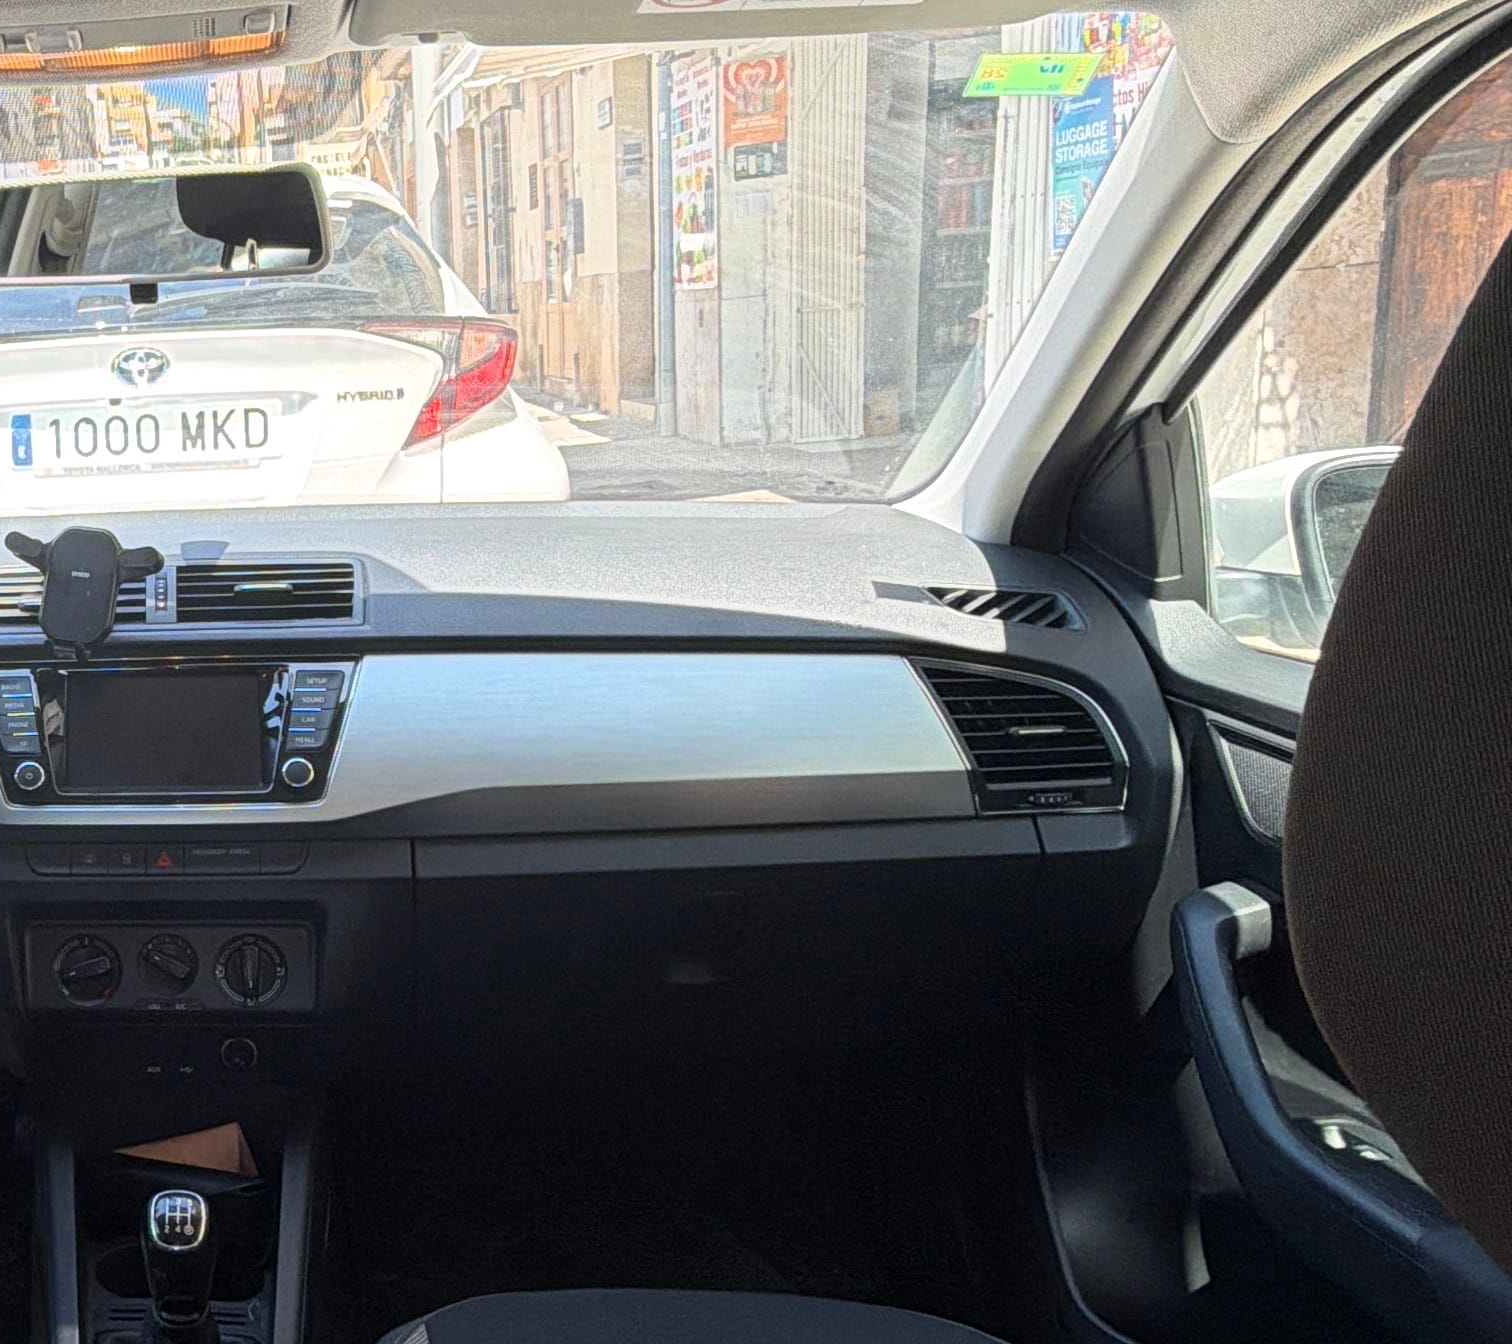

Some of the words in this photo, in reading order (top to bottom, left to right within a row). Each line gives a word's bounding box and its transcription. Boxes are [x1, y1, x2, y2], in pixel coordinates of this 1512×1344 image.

[1055, 120, 1108, 146] LUGGAGE
[1055, 137, 1109, 164] STORAGE
[336, 389, 394, 403] HYBRID
[49, 414, 160, 459] 1000
[181, 407, 269, 452] MKD
